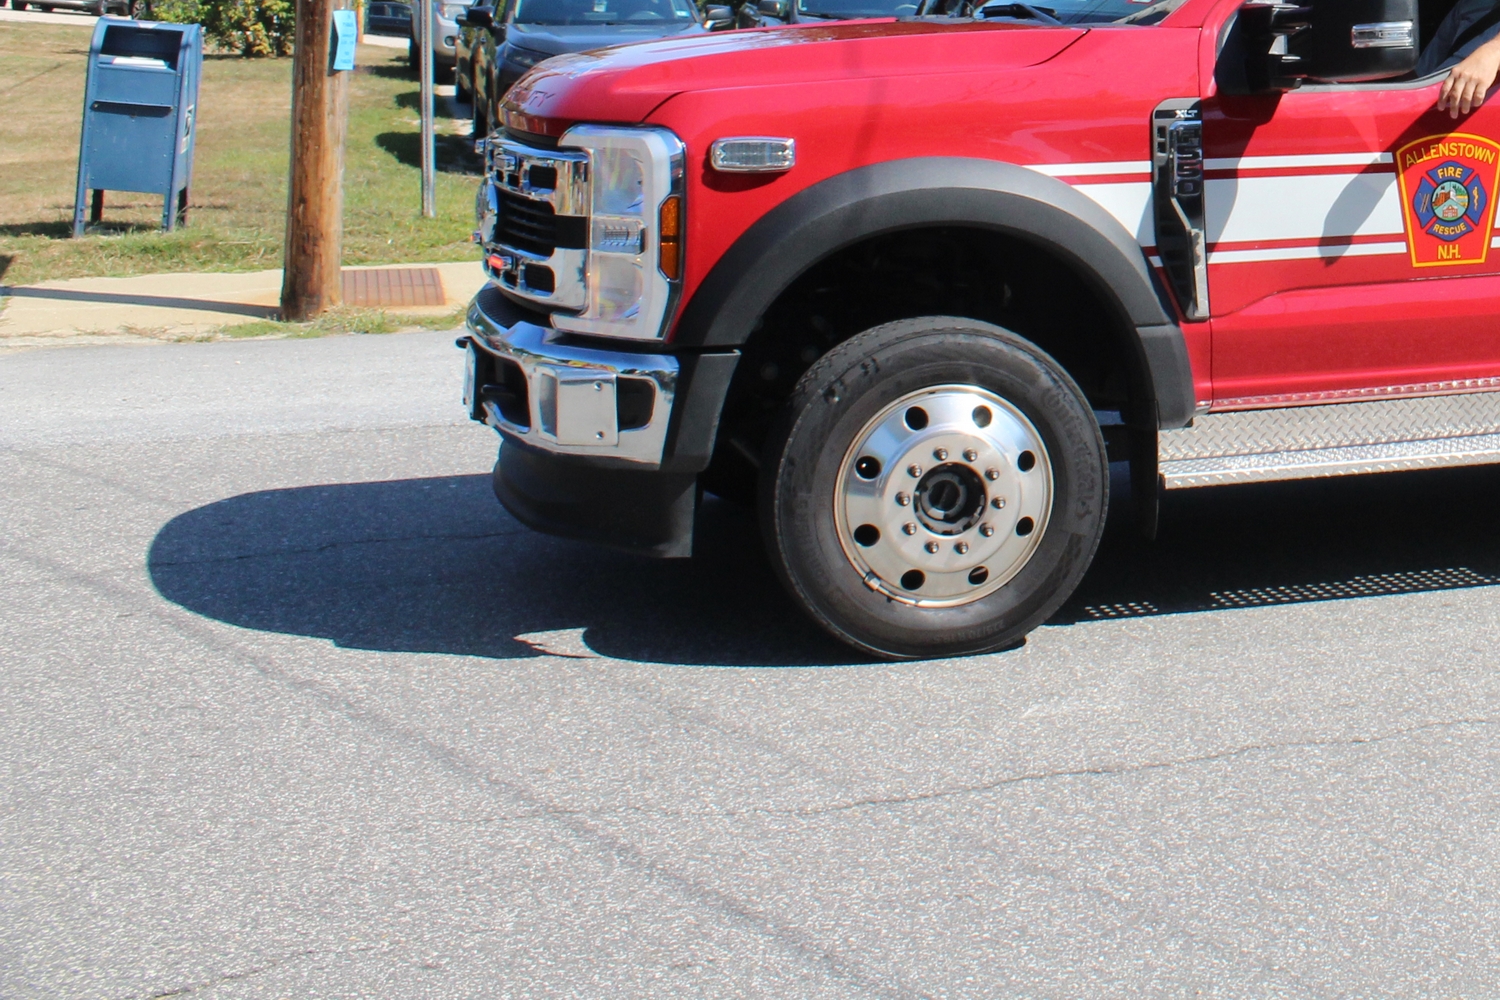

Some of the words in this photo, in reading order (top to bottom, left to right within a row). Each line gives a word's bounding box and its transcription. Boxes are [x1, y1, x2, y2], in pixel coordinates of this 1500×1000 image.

[1175, 110, 1198, 119] XLT
[1405, 142, 1496, 168] ALLENSTOWN
[1437, 166, 1464, 180] FIRE
[1432, 222, 1467, 236] RESCUE
[1437, 244, 1461, 260] N.H.
